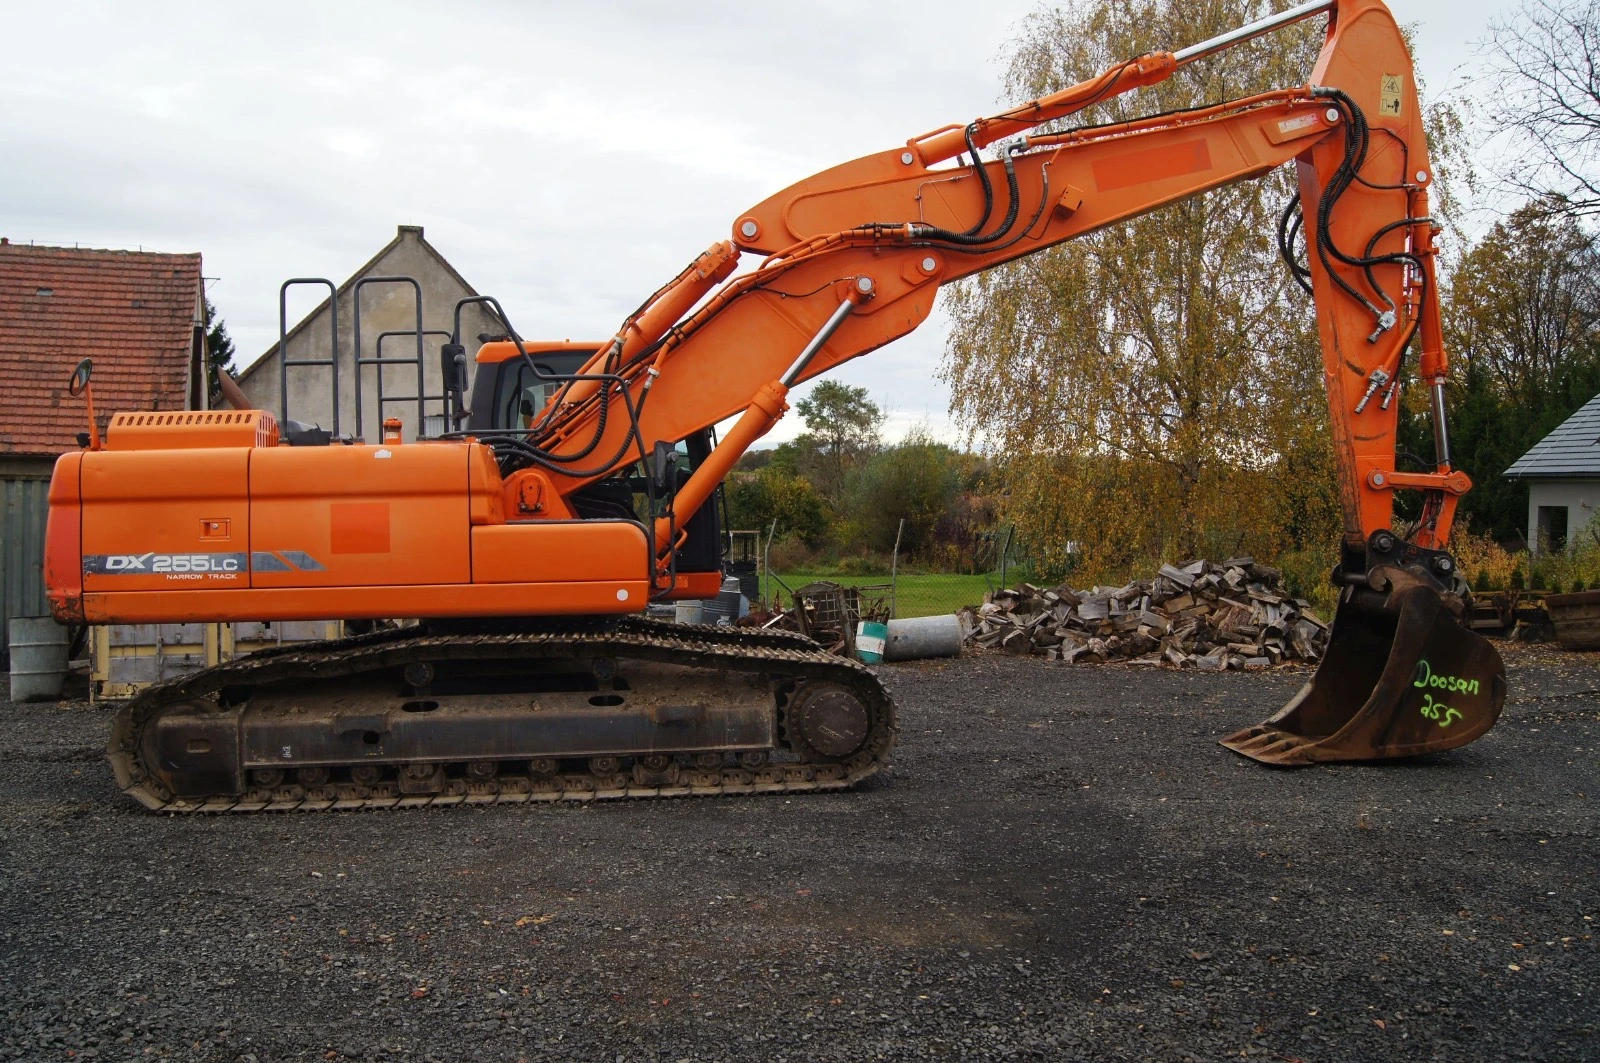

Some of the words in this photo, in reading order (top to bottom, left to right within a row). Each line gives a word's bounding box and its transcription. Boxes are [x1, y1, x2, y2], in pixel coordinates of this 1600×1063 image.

[106, 552, 155, 569] DX
[1414, 660, 1479, 695] Doosan
[1420, 693, 1463, 727] 255
